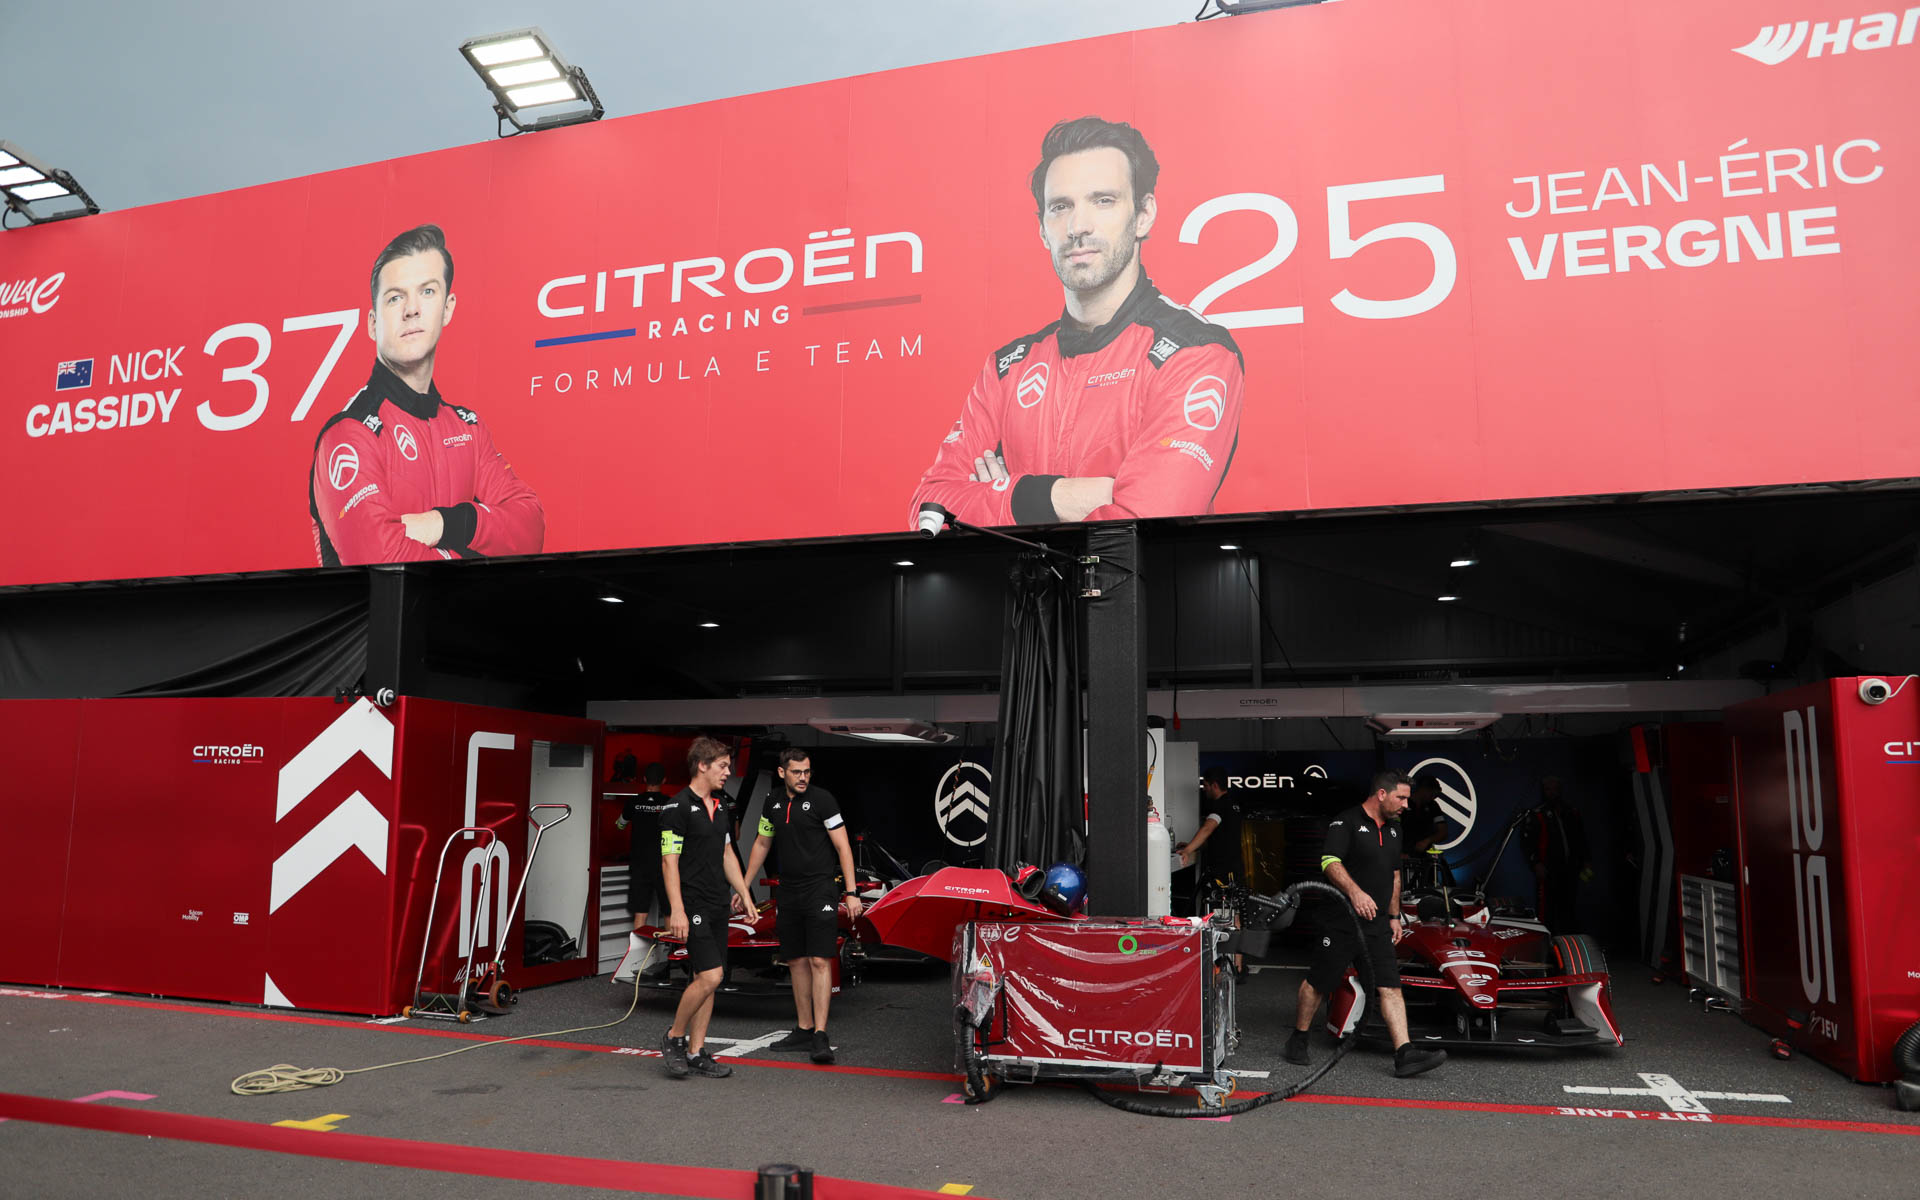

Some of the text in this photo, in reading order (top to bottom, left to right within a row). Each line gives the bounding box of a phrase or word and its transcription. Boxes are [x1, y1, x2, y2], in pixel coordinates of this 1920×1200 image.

[1505, 137, 1885, 218] JEAN-ÉRIC
[1178, 175, 1458, 330] 25
[1506, 206, 1841, 281] VERGNE
[648, 305, 790, 339] RACING
[108, 345, 186, 385] NICK
[196, 309, 361, 432] 37
[530, 334, 923, 396] FORMULA E TEAM
[26, 388, 183, 438] CASSIDY
[1200, 773, 1295, 789] ROËN
[980, 928, 999, 939] FIA
